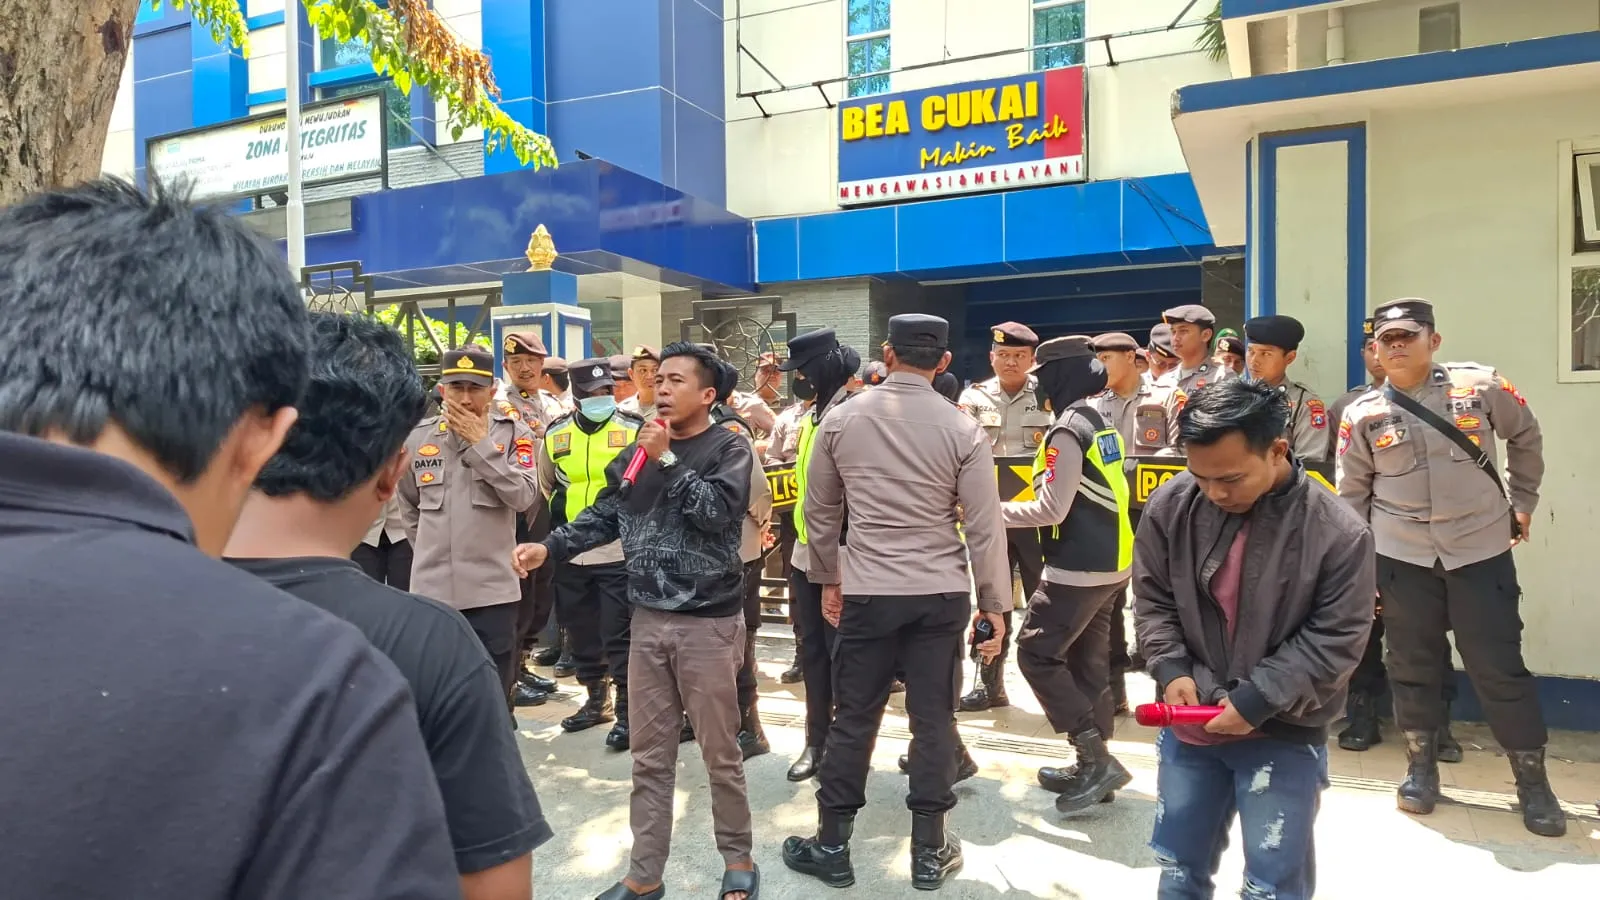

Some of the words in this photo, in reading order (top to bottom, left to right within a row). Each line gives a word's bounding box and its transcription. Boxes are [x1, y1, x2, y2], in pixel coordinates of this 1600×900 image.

[842, 100, 910, 141] BEA
[921, 81, 1039, 131] CUKAI
[245, 136, 281, 160] ZONA
[285, 120, 367, 152] TEGRITAS
[920, 141, 996, 169] Makin
[1005, 114, 1068, 149] Baik
[414, 459, 444, 469] DAYAT
